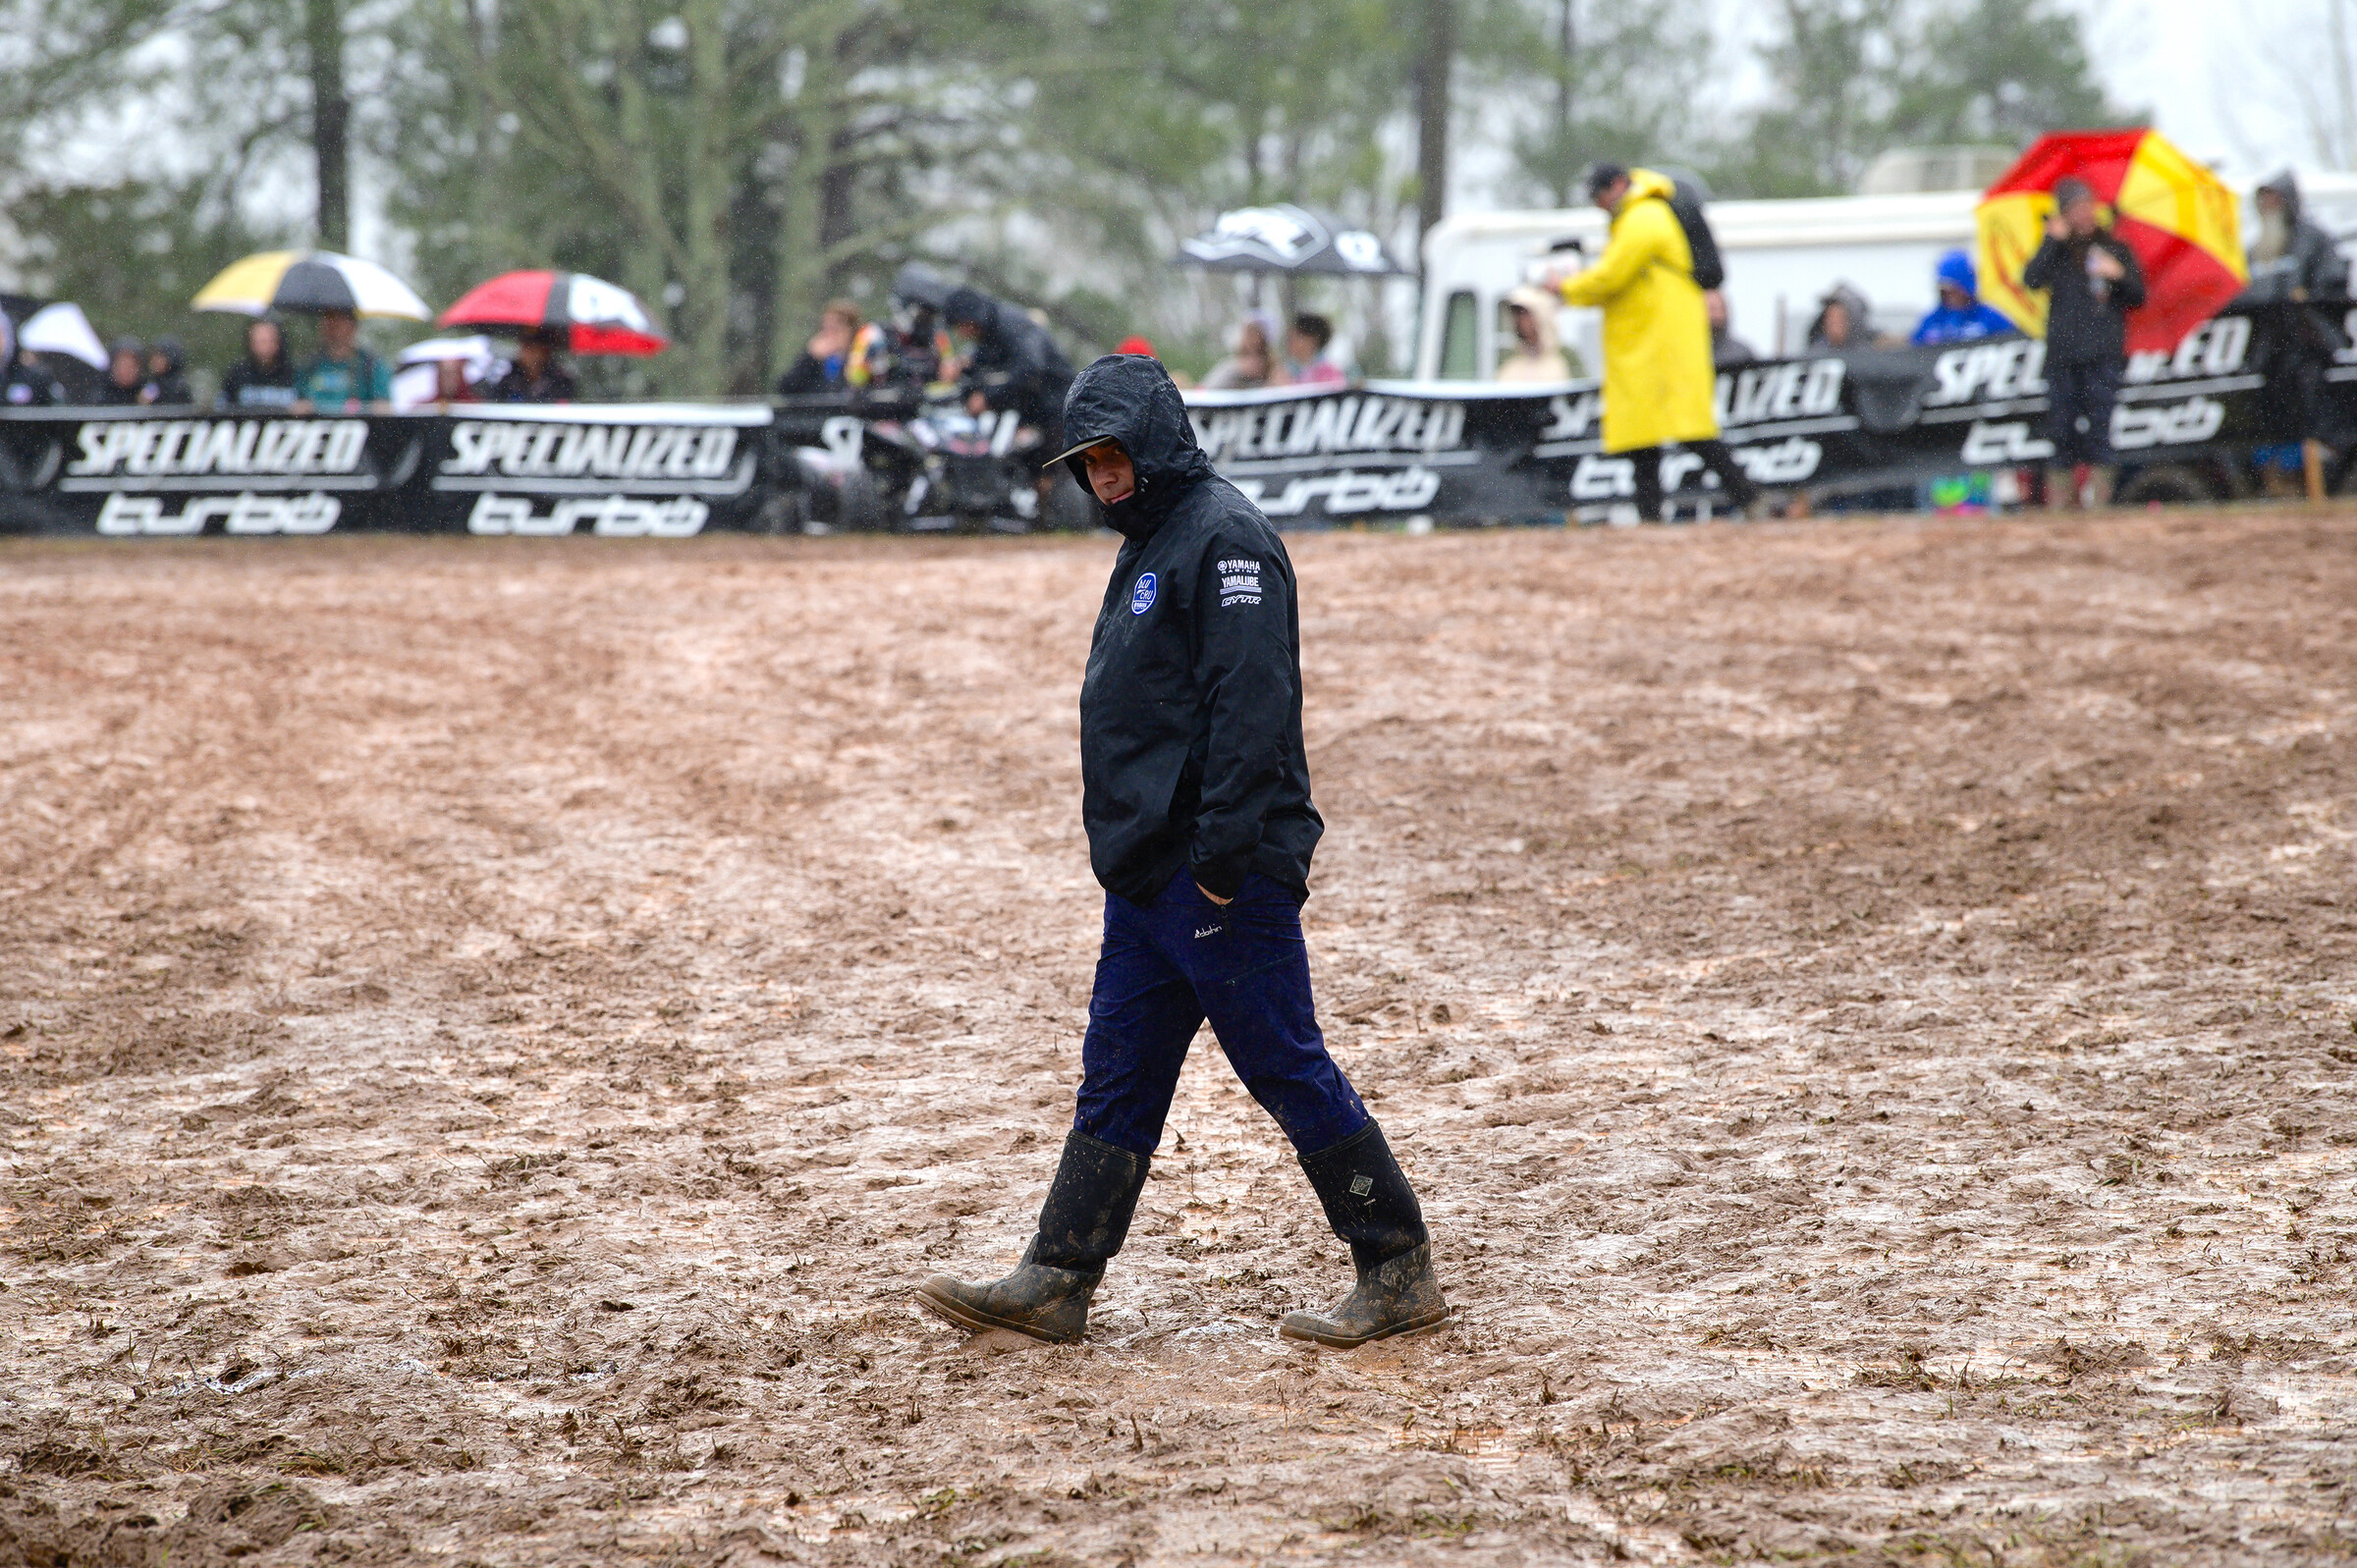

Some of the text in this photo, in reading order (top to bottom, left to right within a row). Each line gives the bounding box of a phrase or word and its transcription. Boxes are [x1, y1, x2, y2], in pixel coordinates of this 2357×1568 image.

[67, 419, 370, 476] SPECIALIZED
[440, 421, 739, 478] SPECIALIZED
[1961, 397, 2225, 465] tubo
[96, 490, 344, 536] turbo
[466, 491, 709, 538] turbo
[1221, 574, 1259, 588] YAMALUBE
[1227, 560, 1261, 571] YAMAHA
[1221, 594, 1262, 607] GYTR
